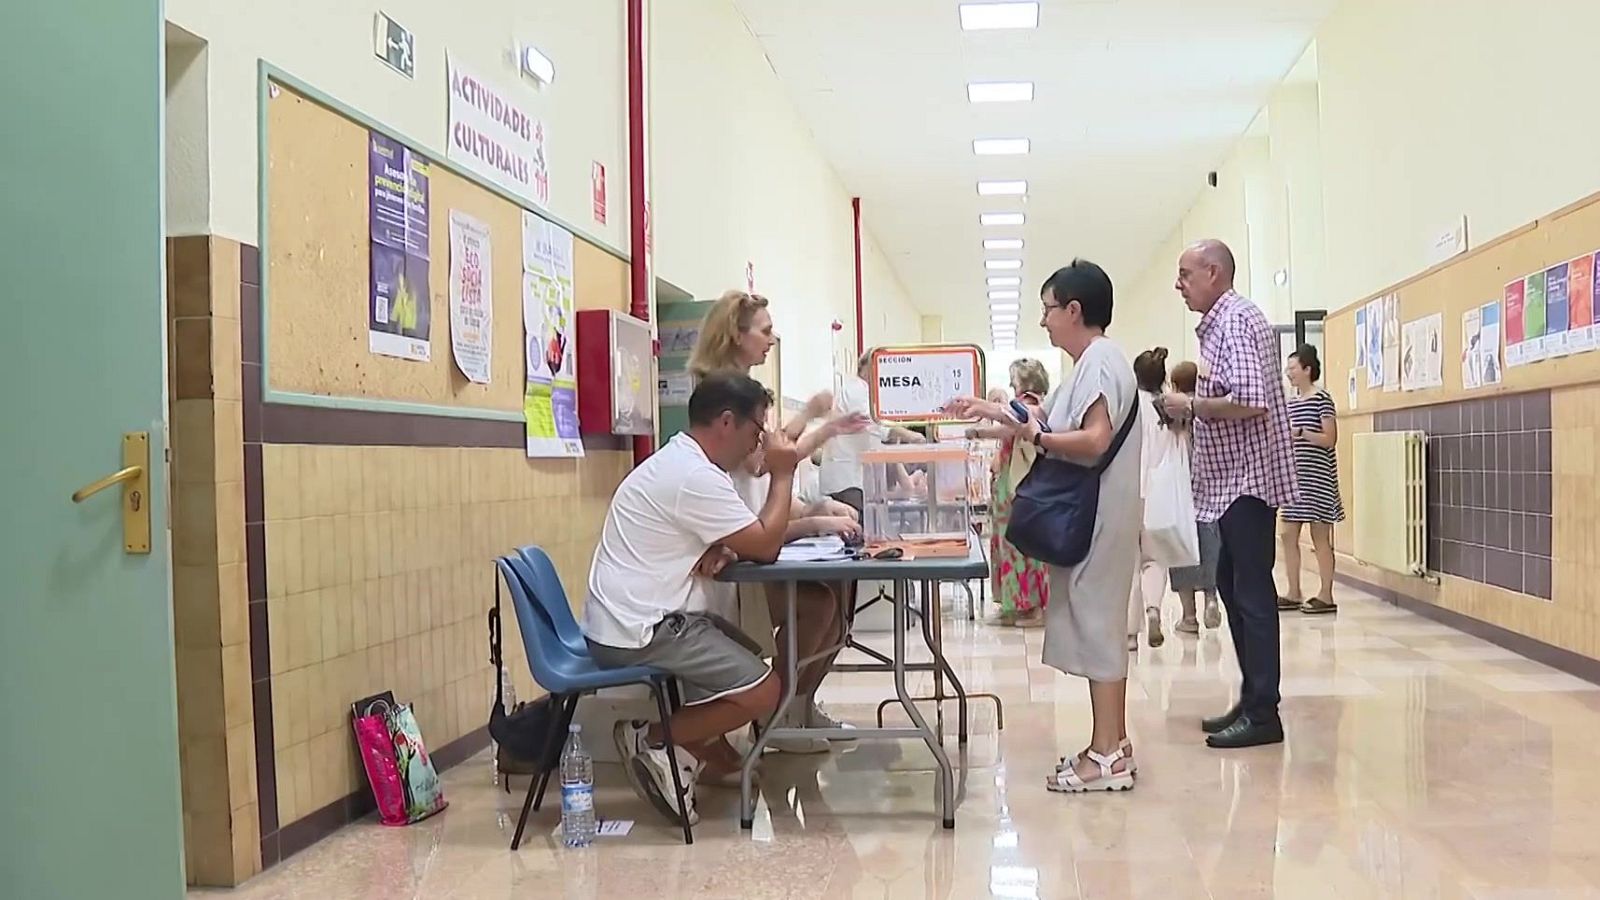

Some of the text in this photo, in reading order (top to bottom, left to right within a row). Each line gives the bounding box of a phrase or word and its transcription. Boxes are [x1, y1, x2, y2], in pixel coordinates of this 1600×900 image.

[451, 68, 531, 142] ACTIVIDADES
[453, 121, 529, 185] CULTURALES
[953, 369, 962, 378] 15
[879, 376, 922, 388] MESA
[954, 383, 960, 391] U
